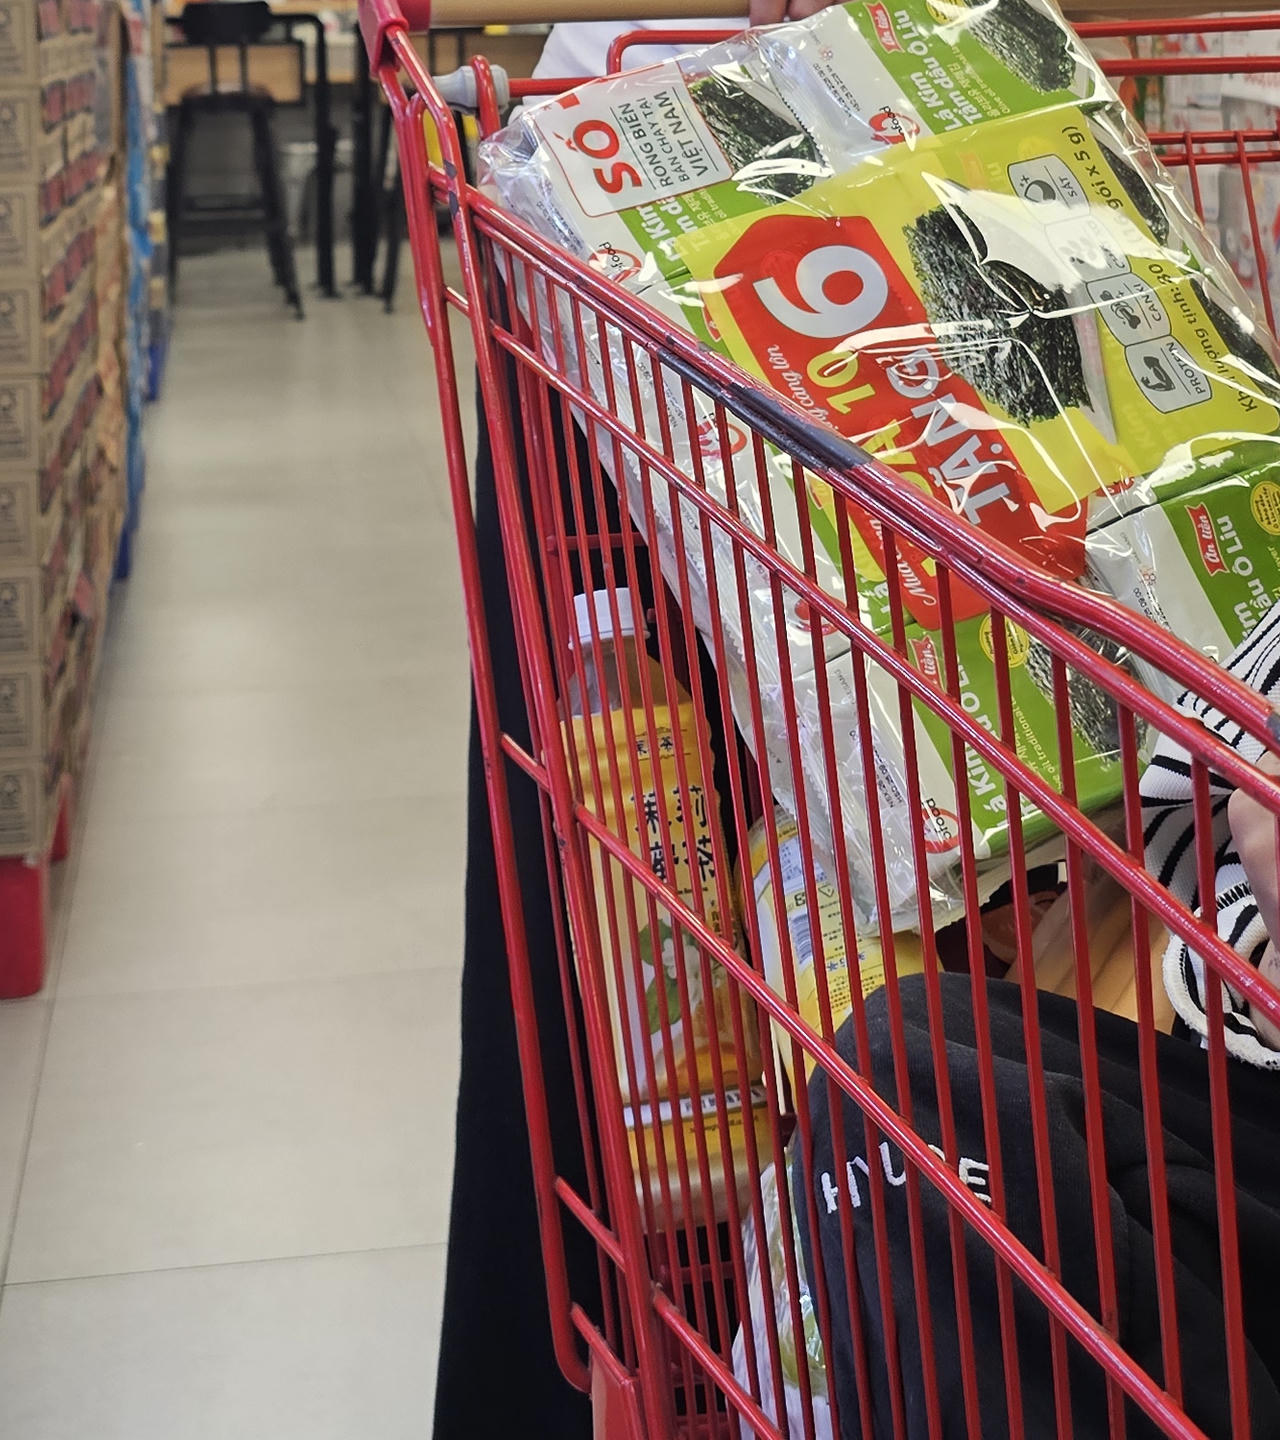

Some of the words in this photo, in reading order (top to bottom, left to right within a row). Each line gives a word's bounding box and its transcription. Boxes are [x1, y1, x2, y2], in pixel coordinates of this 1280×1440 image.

[891, 9, 920, 42] Liu
[903, 38, 931, 62] Ô
[908, 70, 945, 110] Kim
[617, 103, 646, 141] BIỂN
[656, 91, 686, 135] NAM
[937, 109, 964, 132] Lá
[648, 119, 675, 154] CHẠY
[1061, 123, 1086, 147] g)
[552, 119, 642, 194] SỐ
[641, 142, 673, 187] RONG
[666, 156, 690, 182] BÁN
[680, 137, 709, 177] VIỆT
[1074, 149, 1093, 165] 5
[807, 349, 876, 415] 10
[1215, 515, 1244, 555] Liu
[1230, 555, 1256, 580] Ô
